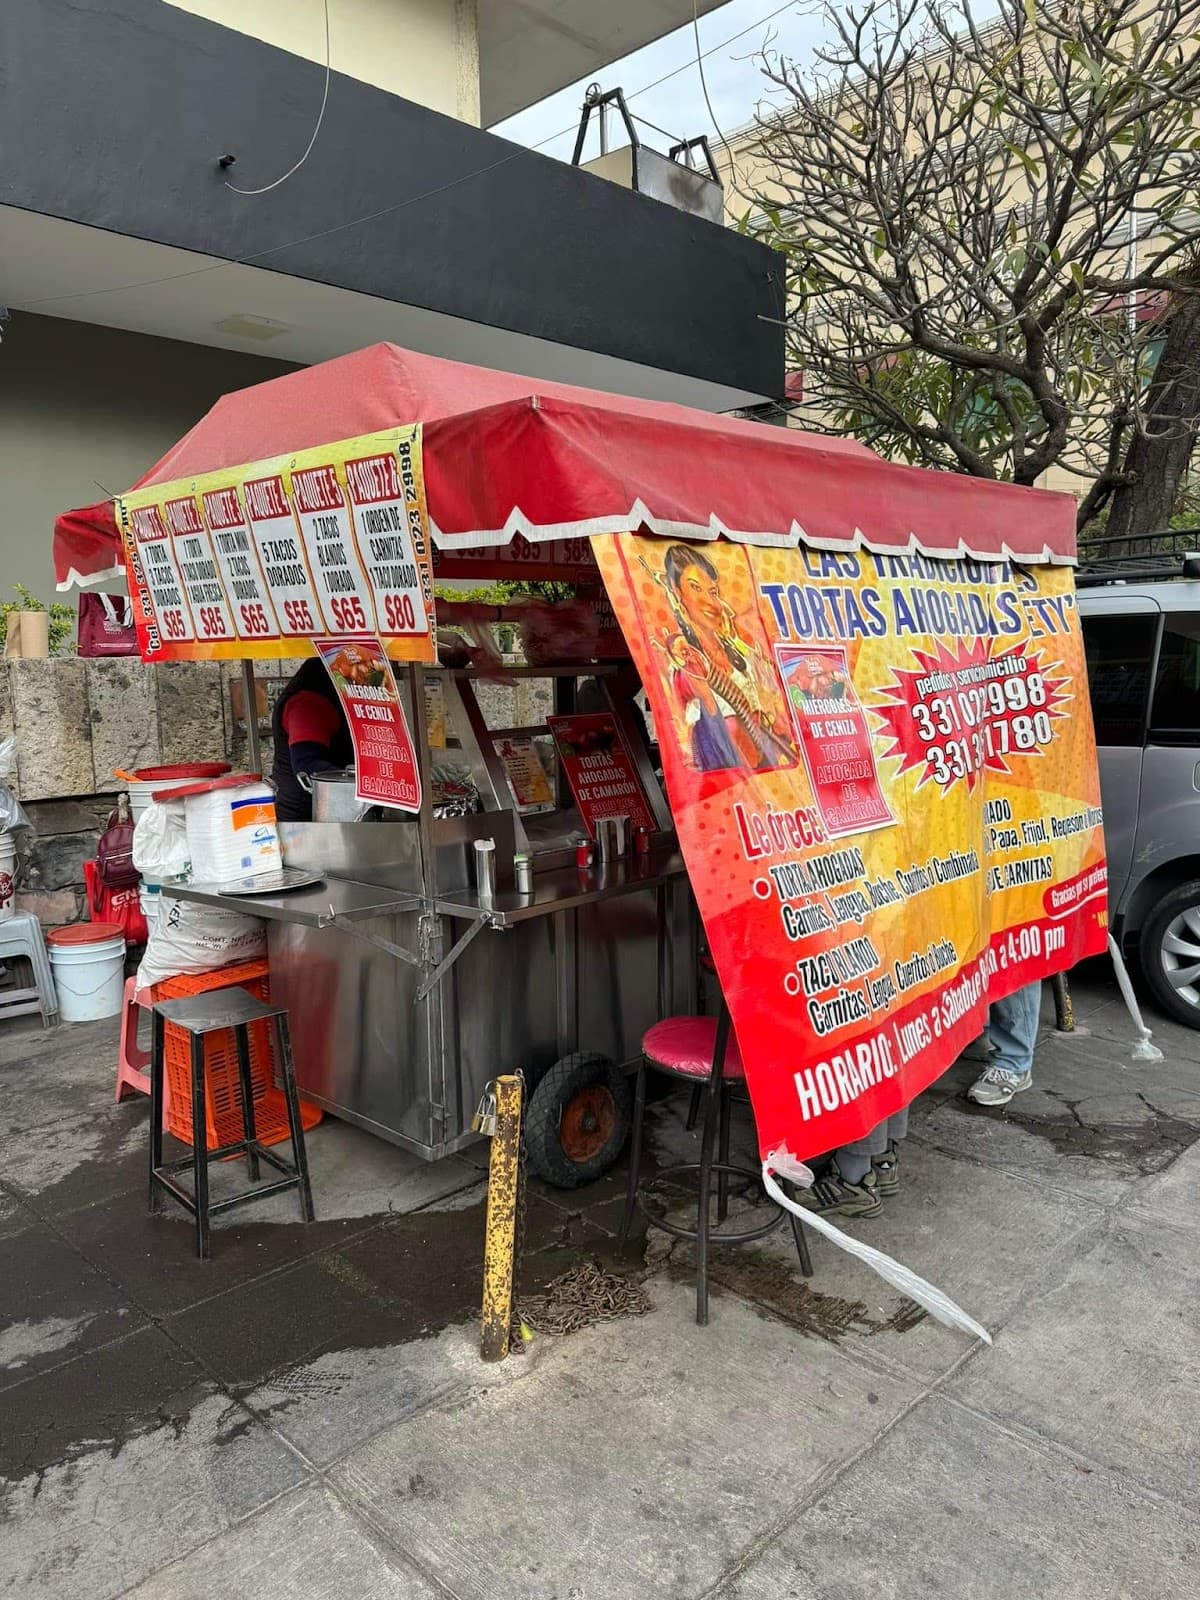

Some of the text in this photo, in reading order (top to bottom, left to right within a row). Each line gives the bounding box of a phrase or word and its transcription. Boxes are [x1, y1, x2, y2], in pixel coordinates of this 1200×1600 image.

[347, 456, 399, 503] PAQUETE 6
[399, 441, 418, 502] 2998
[244, 480, 281, 521] PAQUETE
[292, 466, 344, 513] PAQUETE 5
[203, 490, 237, 529] PAQUETE
[366, 508, 390, 535] ORDEN
[388, 506, 402, 531] DE
[313, 515, 340, 541] 2 TACOS
[410, 509, 425, 556] 023
[261, 538, 298, 563] 5 TACOS
[316, 542, 347, 567] BLANDOS
[369, 536, 404, 564] CARNITAS
[154, 566, 175, 585] TACOS
[234, 555, 251, 576] TACOS
[267, 564, 307, 588] DORADOS
[389, 564, 418, 588] DORADO
[232, 579, 260, 600] DORADOS
[328, 569, 356, 593] DORADO
[139, 588, 153, 617] 331
[153, 587, 182, 607] DORADOS
[163, 609, 186, 637] $85
[200, 606, 226, 636] $85
[240, 604, 269, 634] $65
[284, 599, 315, 631] $55
[331, 596, 367, 633] $65
[385, 594, 415, 632] $80
[760, 584, 887, 639] TORTAS
[353, 703, 395, 722] DE CENIZA
[801, 694, 854, 716] MIÉRCOLES
[362, 723, 398, 744] TORTA
[810, 718, 858, 739] DE CENIZA
[360, 740, 411, 764] AHOGADA
[579, 754, 615, 769] TORTAS
[821, 741, 860, 763] TORTA
[379, 761, 394, 779] DE
[578, 767, 627, 785] AHOGADAS
[817, 760, 873, 785] AHOGADA
[362, 774, 416, 801] CAMARÓN
[578, 780, 637, 801] DE CAMARÓN
[841, 782, 858, 801] DE
[826, 796, 886, 826] CAMARÓN
[735, 804, 771, 858] Le
[990, 827, 1022, 853] Papa,
[1021, 820, 1050, 846] Frijol,
[807, 848, 865, 893] AHOGADAS
[825, 891, 872, 923] Lengua,
[864, 877, 904, 910] Buche,
[1051, 882, 1077, 909] Gracias
[799, 937, 880, 993] TACO BLANDO
[793, 1037, 898, 1121] HORARIO:
[893, 1013, 932, 1063] Lunes
[931, 1006, 942, 1037] a
[999, 944, 1008, 969] a
[1007, 925, 1041, 964] 4:00
[1043, 923, 1066, 960] pm
[809, 990, 870, 1033] Carnitas,
